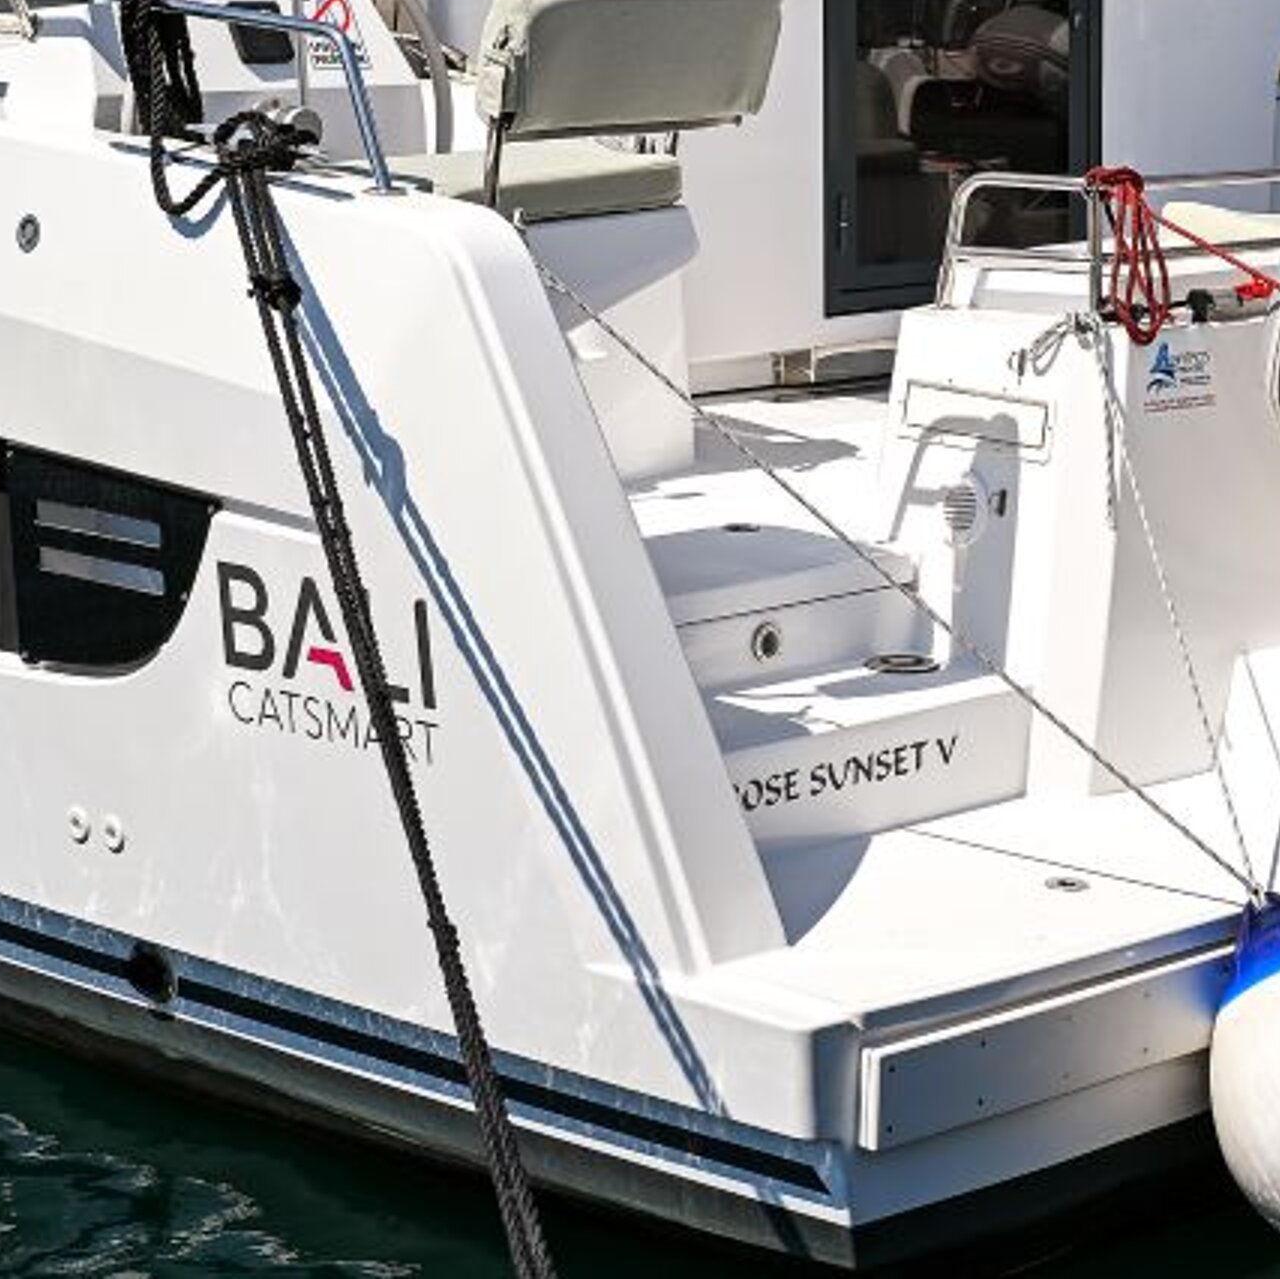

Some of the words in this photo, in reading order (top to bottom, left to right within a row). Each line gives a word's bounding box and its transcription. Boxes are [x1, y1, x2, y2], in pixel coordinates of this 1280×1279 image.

[733, 769, 801, 812] OSE
[810, 740, 929, 797] SUNSET
[935, 736, 959, 765] V
